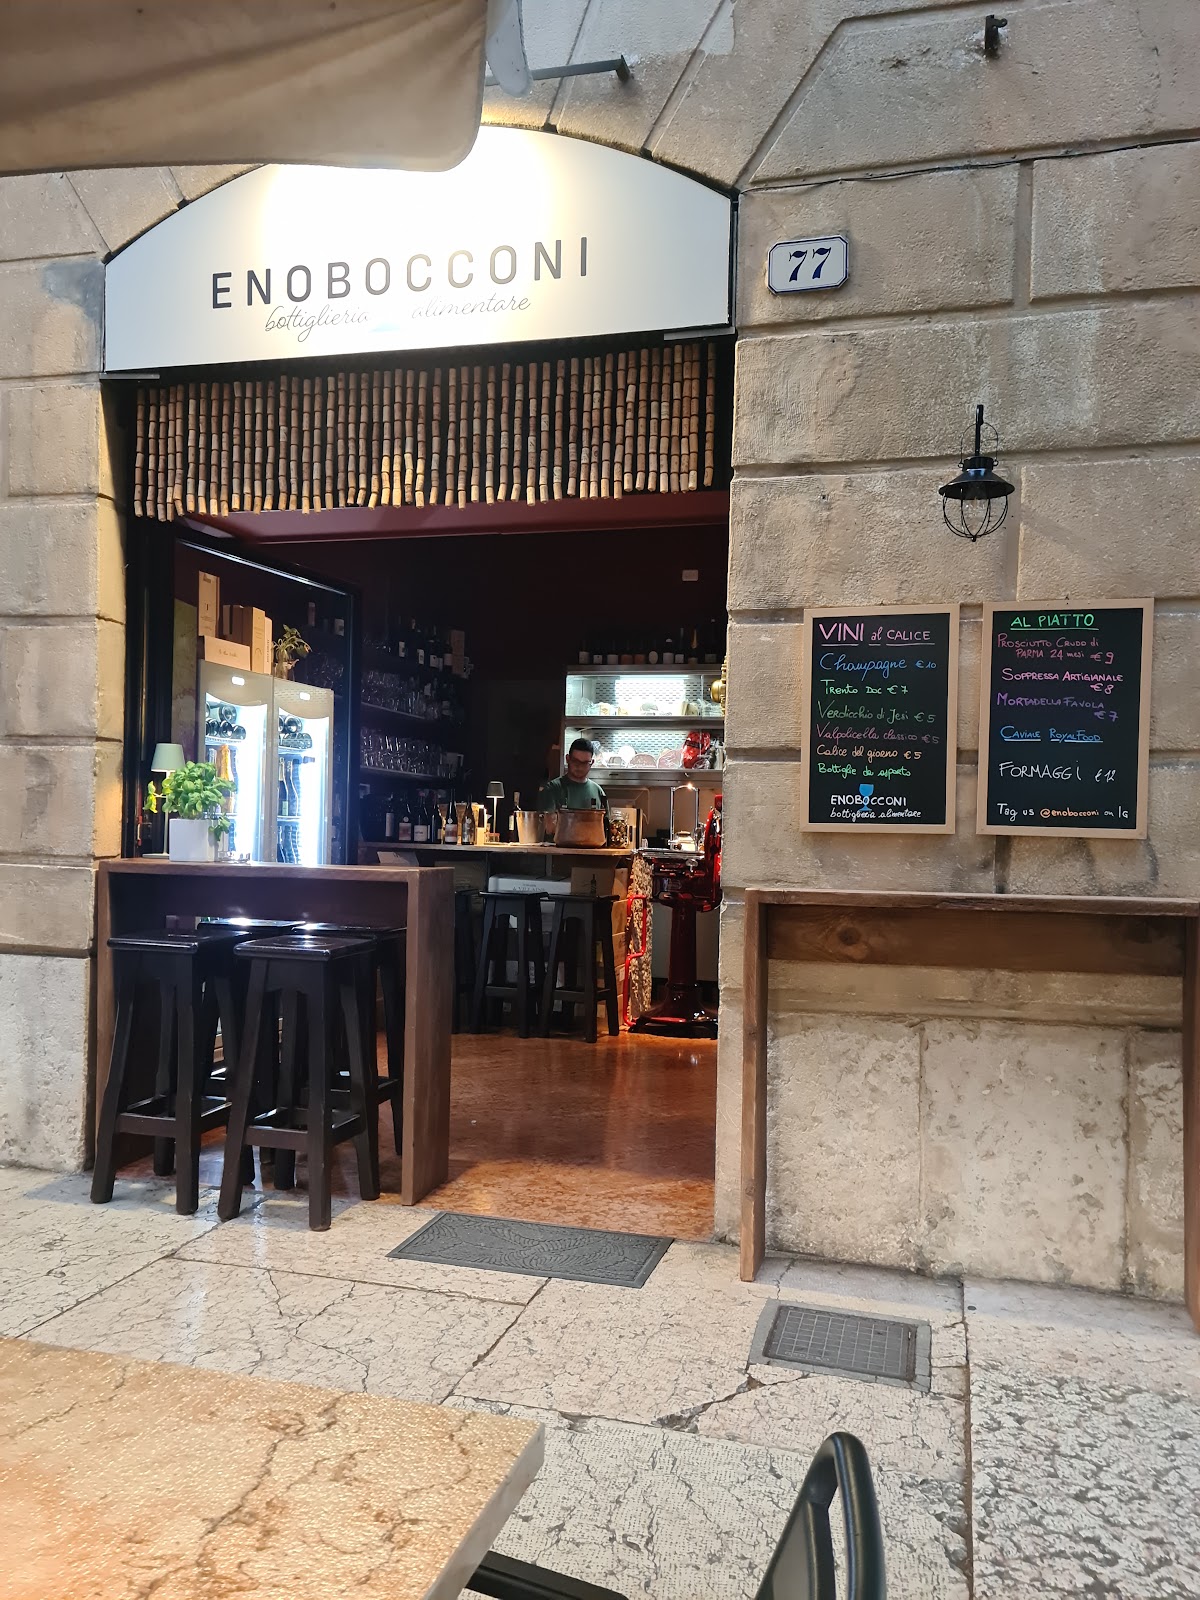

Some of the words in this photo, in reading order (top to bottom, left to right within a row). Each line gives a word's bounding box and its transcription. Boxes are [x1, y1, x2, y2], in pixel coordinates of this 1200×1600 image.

[212, 237, 587, 309] ENOBOCCONI
[789, 247, 831, 282] 77
[265, 304, 369, 342] bottiglieria
[412, 293, 531, 318] alimentare
[1010, 617, 1031, 627] AL
[1038, 614, 1094, 627] PIATTO
[819, 623, 864, 641] VINI
[871, 626, 883, 640] al
[886, 630, 931, 640] CALICE
[1090, 637, 1099, 646] di
[1016, 649, 1044, 658] PARMA
[1050, 650, 1063, 660] 24
[820, 653, 907, 681] Champagne
[818, 700, 873, 719] Verdicchio
[877, 708, 886, 719] di
[887, 709, 908, 724] Jesi
[816, 721, 879, 745] Valpolicella
[817, 745, 847, 757] Calice
[852, 746, 864, 757] del
[818, 763, 856, 779] Bottiglie
[863, 766, 874, 776] da
[830, 795, 907, 806] ENOBOCCONI
[997, 804, 1018, 821] Tag
[1040, 807, 1100, 818] @enobocconi
